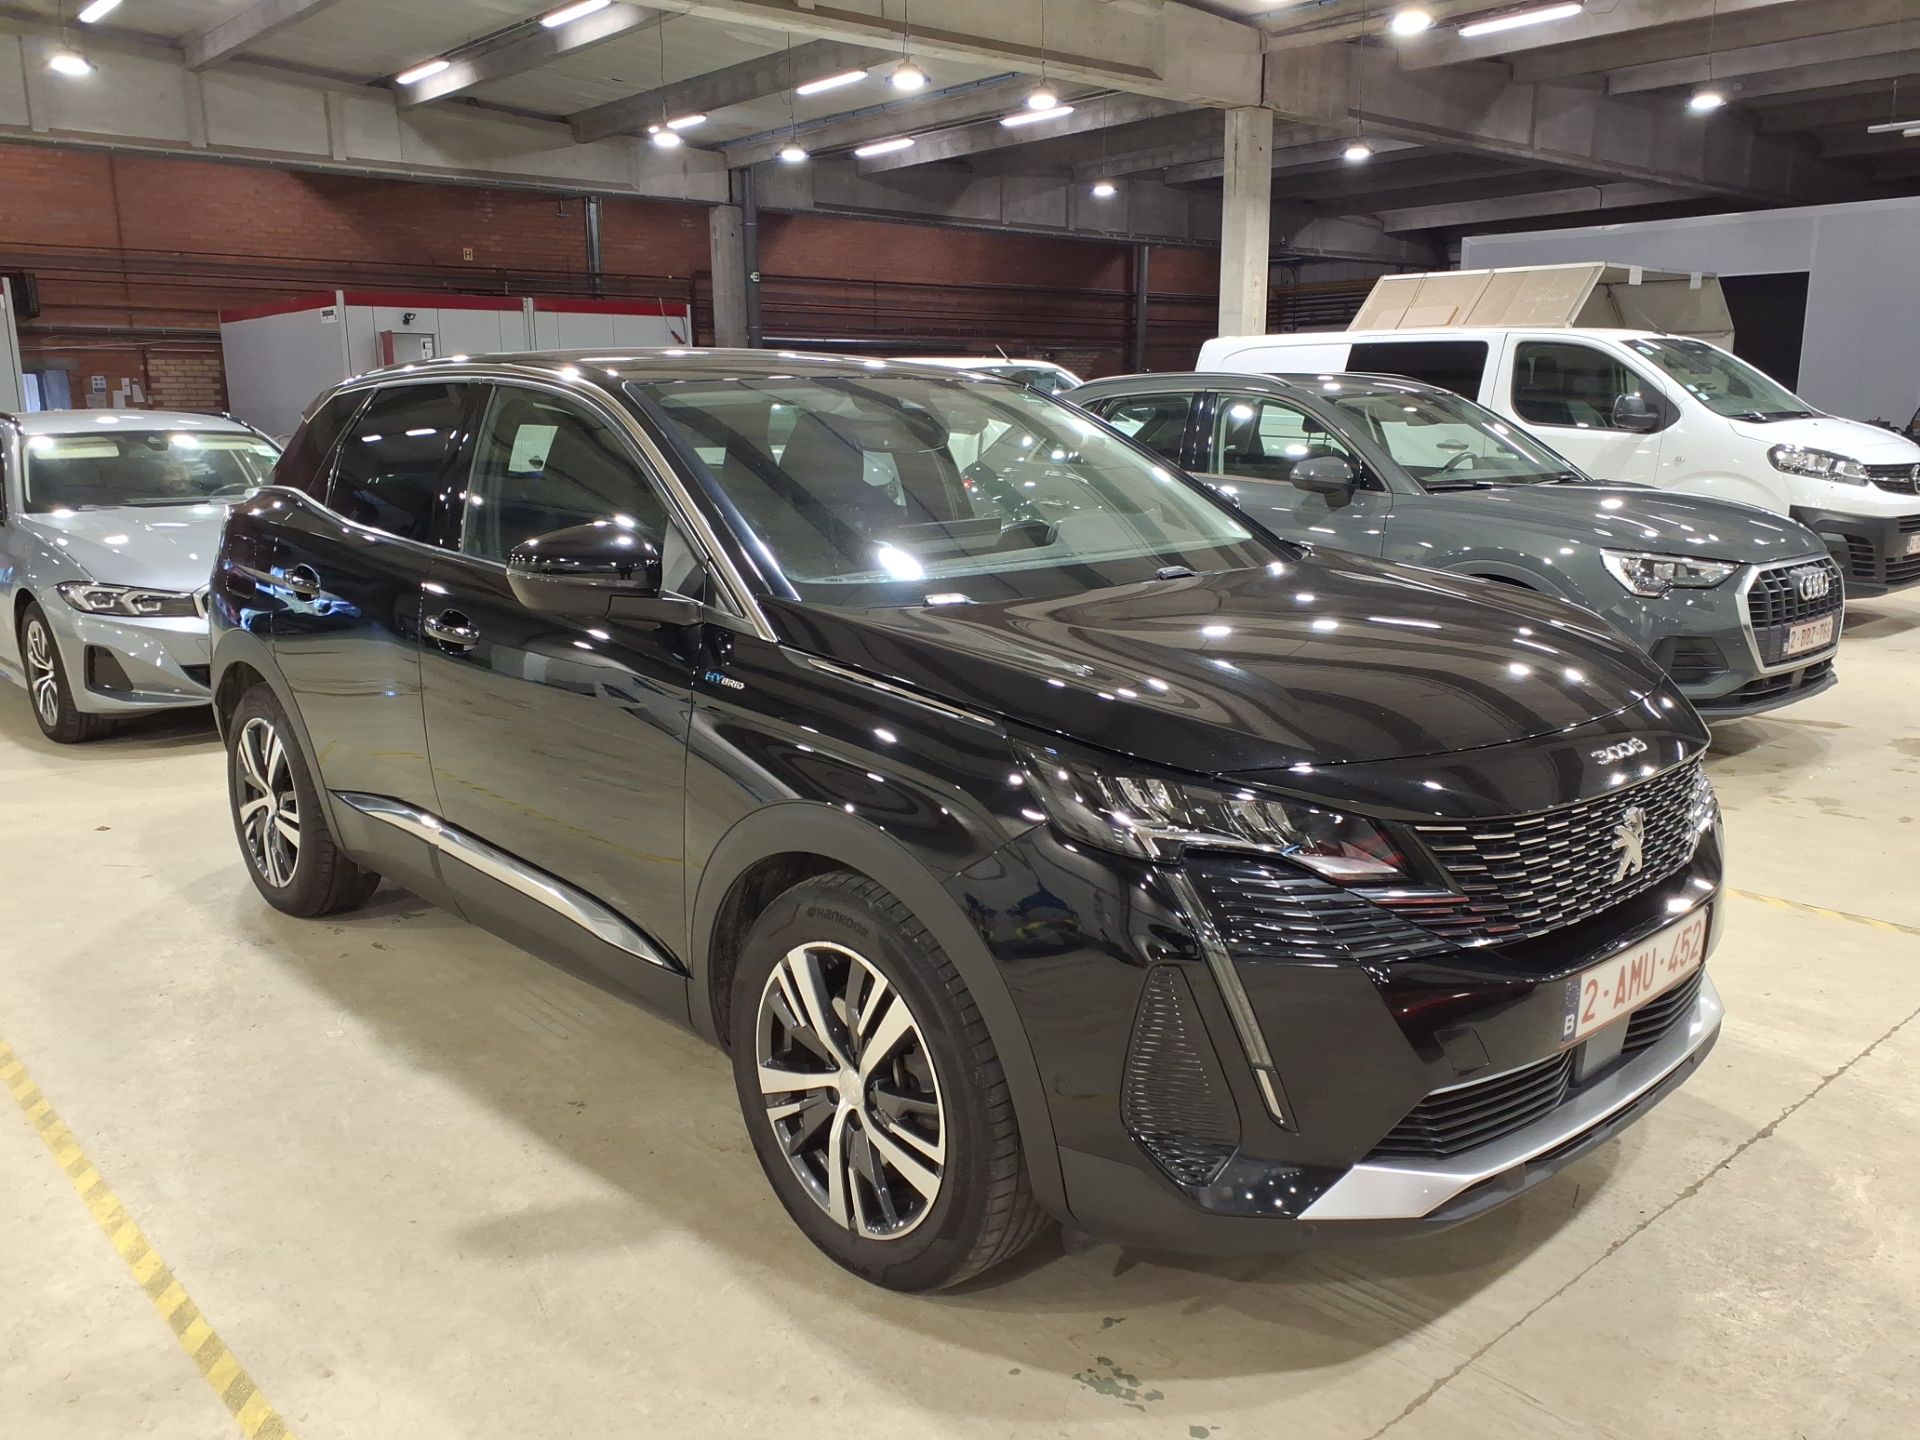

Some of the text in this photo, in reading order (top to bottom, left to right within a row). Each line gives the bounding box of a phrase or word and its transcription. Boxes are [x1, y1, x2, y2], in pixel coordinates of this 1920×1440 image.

[704, 671, 745, 690] HYBRID
[1590, 737, 1648, 765] 3008
[1563, 919, 1702, 1036] B 2-AMU-452
